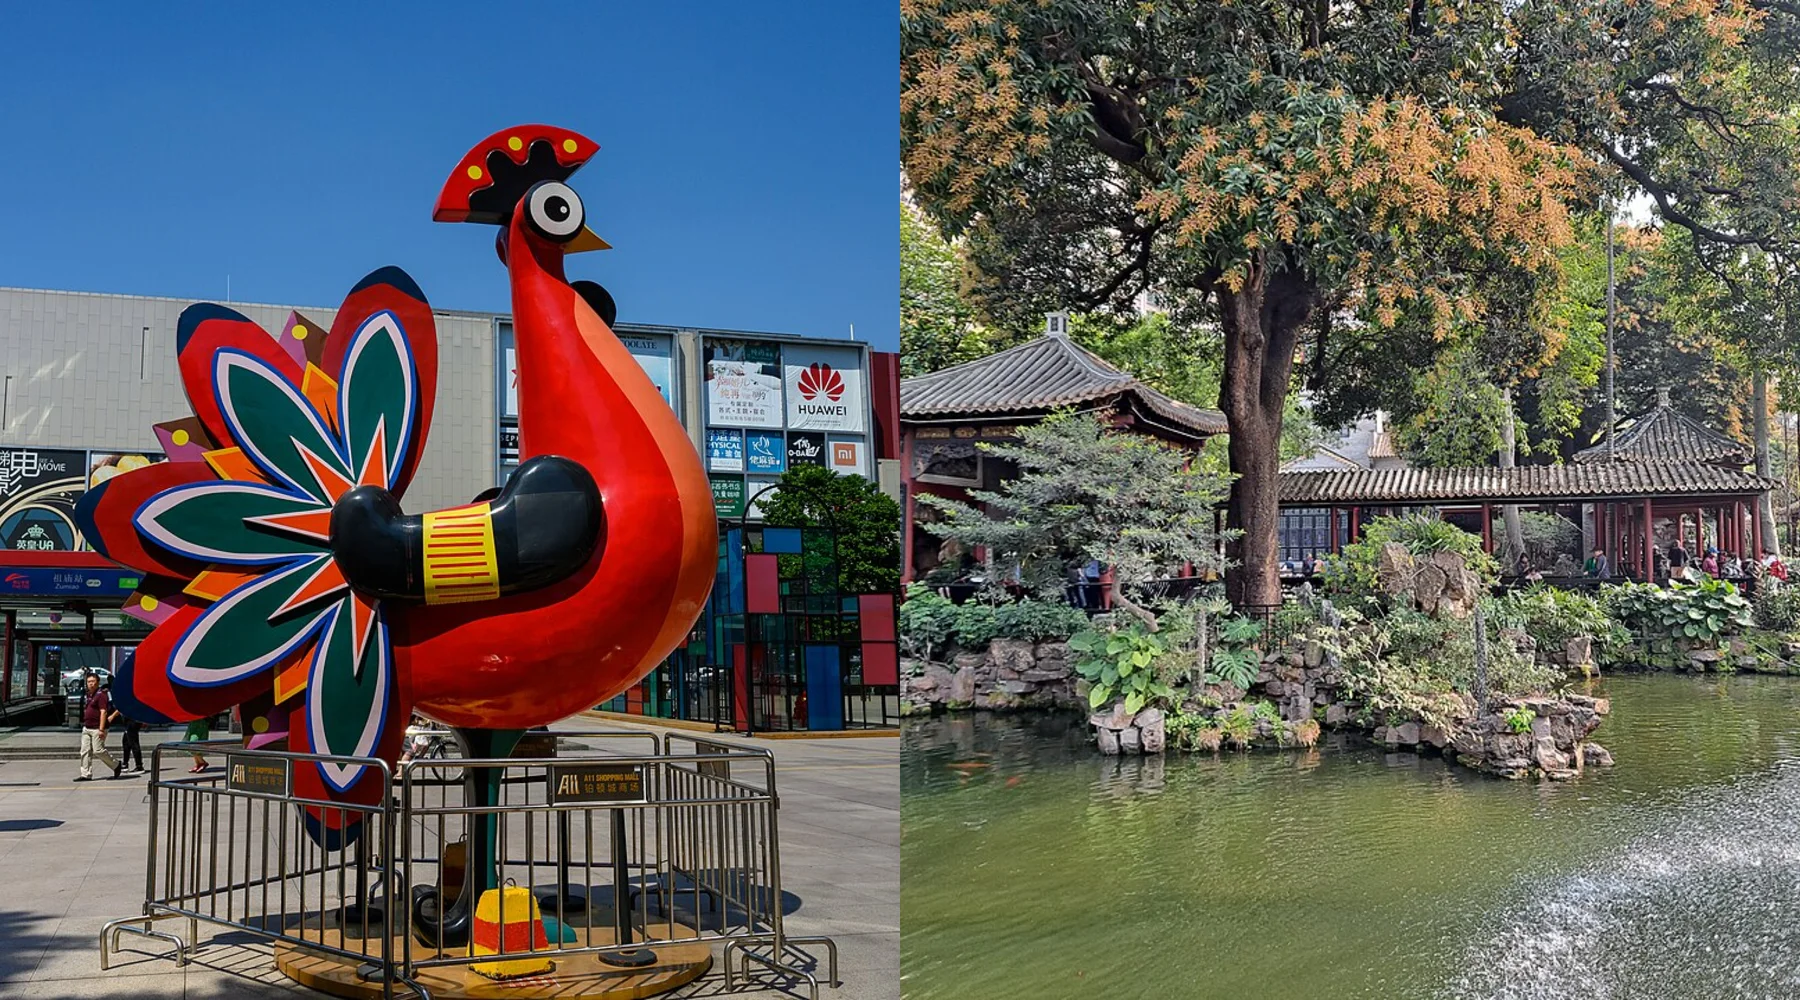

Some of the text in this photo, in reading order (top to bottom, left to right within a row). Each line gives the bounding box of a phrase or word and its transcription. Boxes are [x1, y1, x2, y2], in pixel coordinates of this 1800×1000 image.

[798, 404, 848, 417] HUAWEI
[38, 463, 67, 472] MOVIE
[584, 773, 639, 782] A11 SHOPPING MALL
